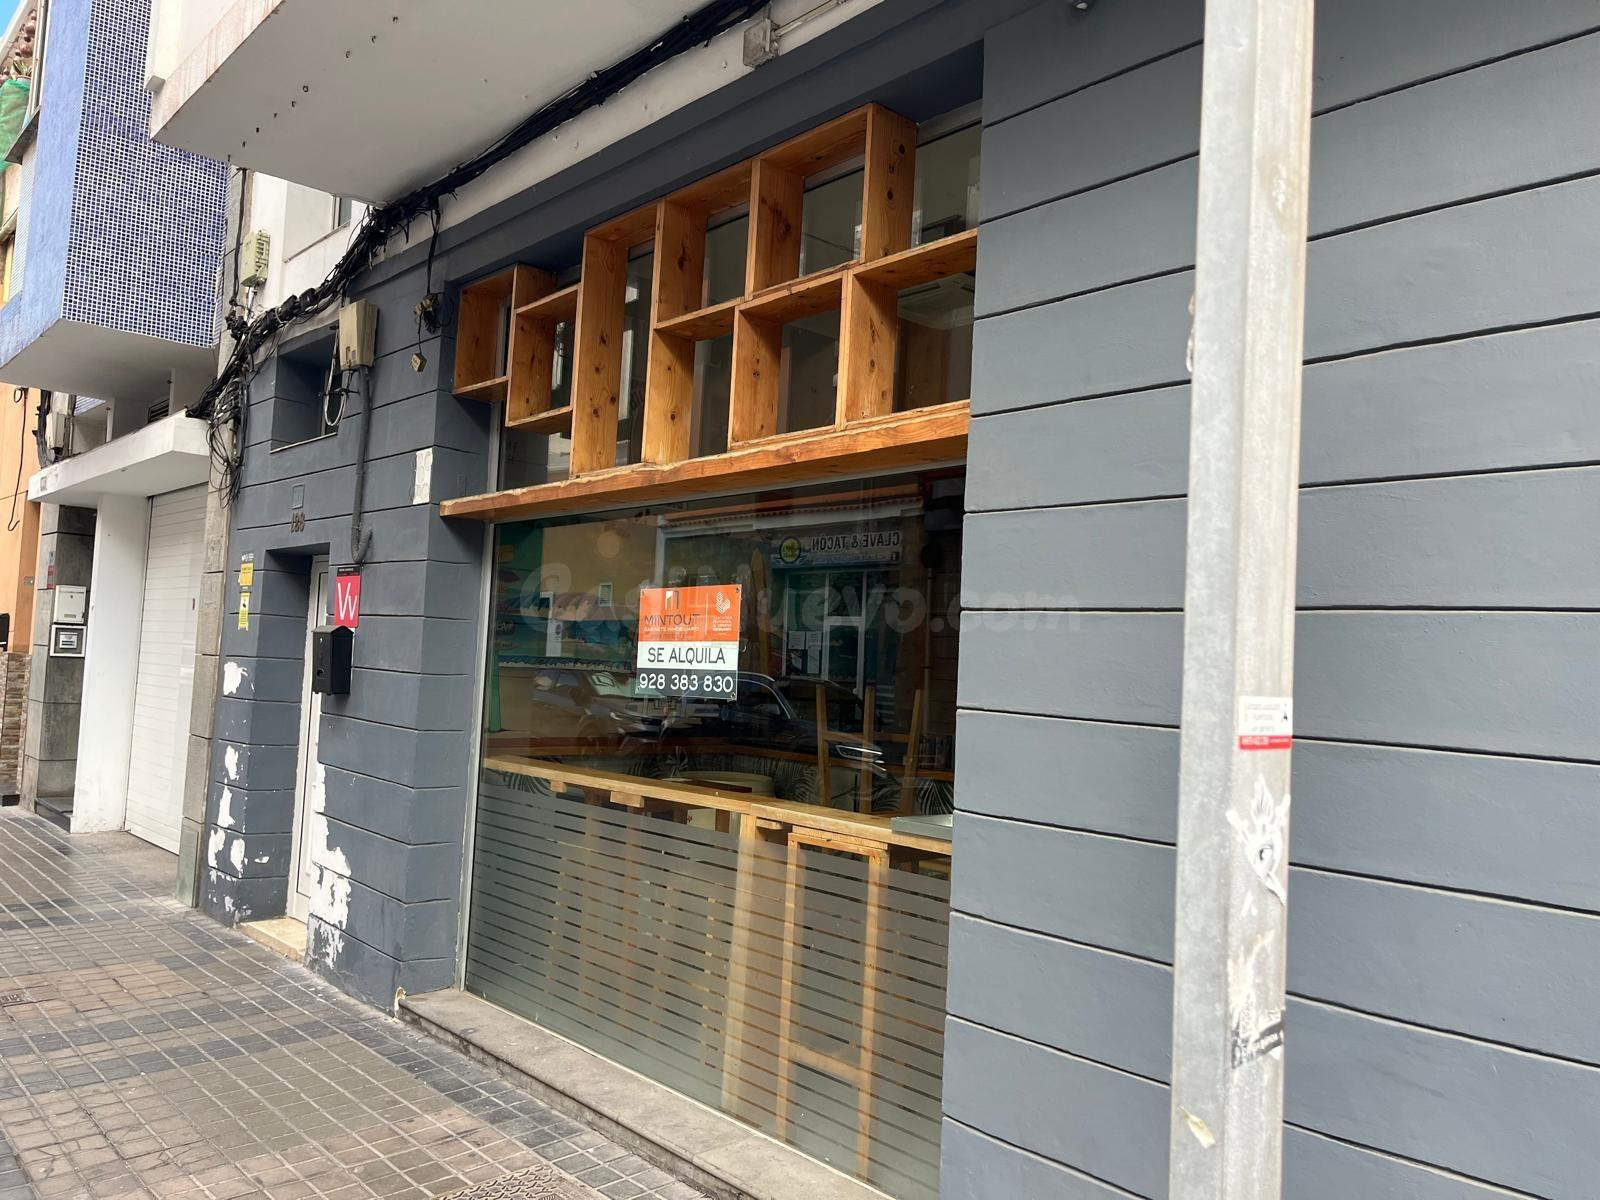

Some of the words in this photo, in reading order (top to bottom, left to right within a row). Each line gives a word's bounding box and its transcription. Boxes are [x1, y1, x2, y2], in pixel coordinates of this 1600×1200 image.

[645, 613, 701, 626] MINTOUT
[647, 646, 665, 663] SE
[668, 647, 726, 665] ALQUILA
[639, 673, 666, 690] 928
[670, 674, 699, 691] 383
[703, 675, 734, 693] 830
